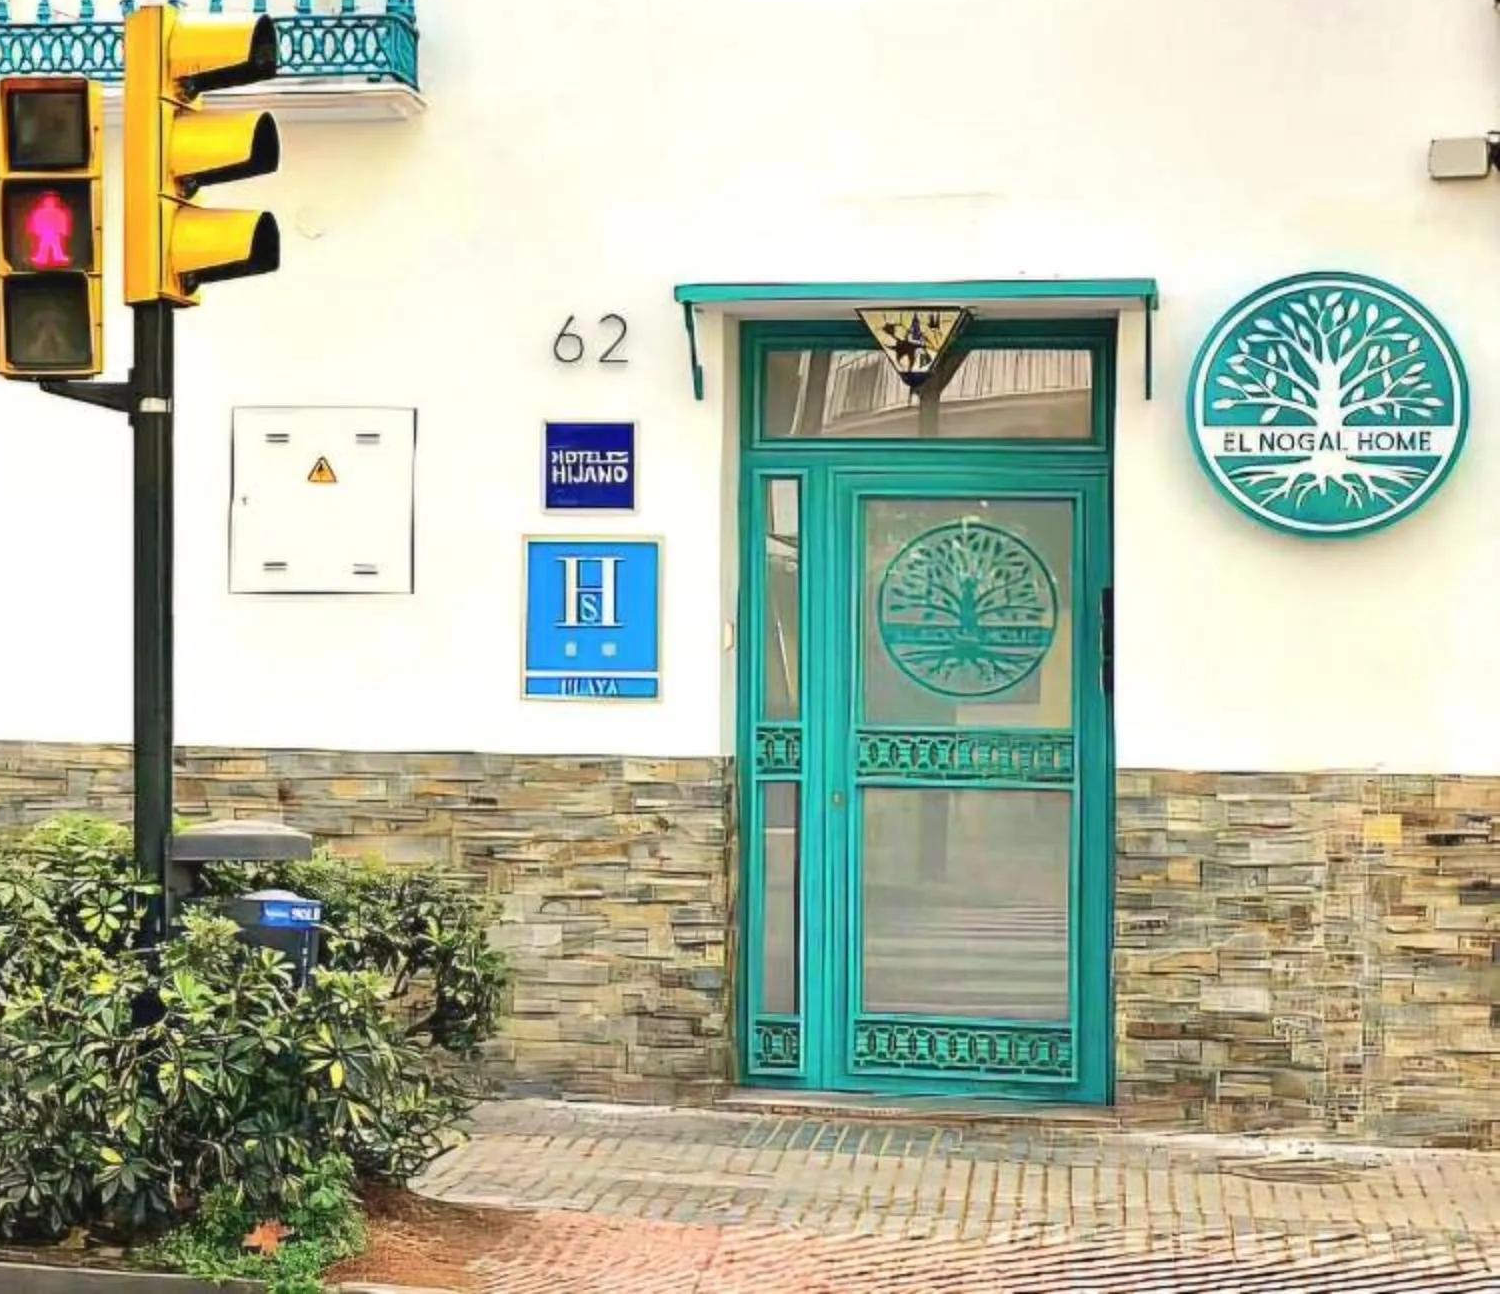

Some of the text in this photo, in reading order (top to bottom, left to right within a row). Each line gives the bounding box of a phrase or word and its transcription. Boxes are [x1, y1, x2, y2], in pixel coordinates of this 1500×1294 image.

[553, 313, 629, 363] 62
[1223, 431, 1431, 453] EL NOGAL HOME
[552, 465, 629, 483] HIJANO
